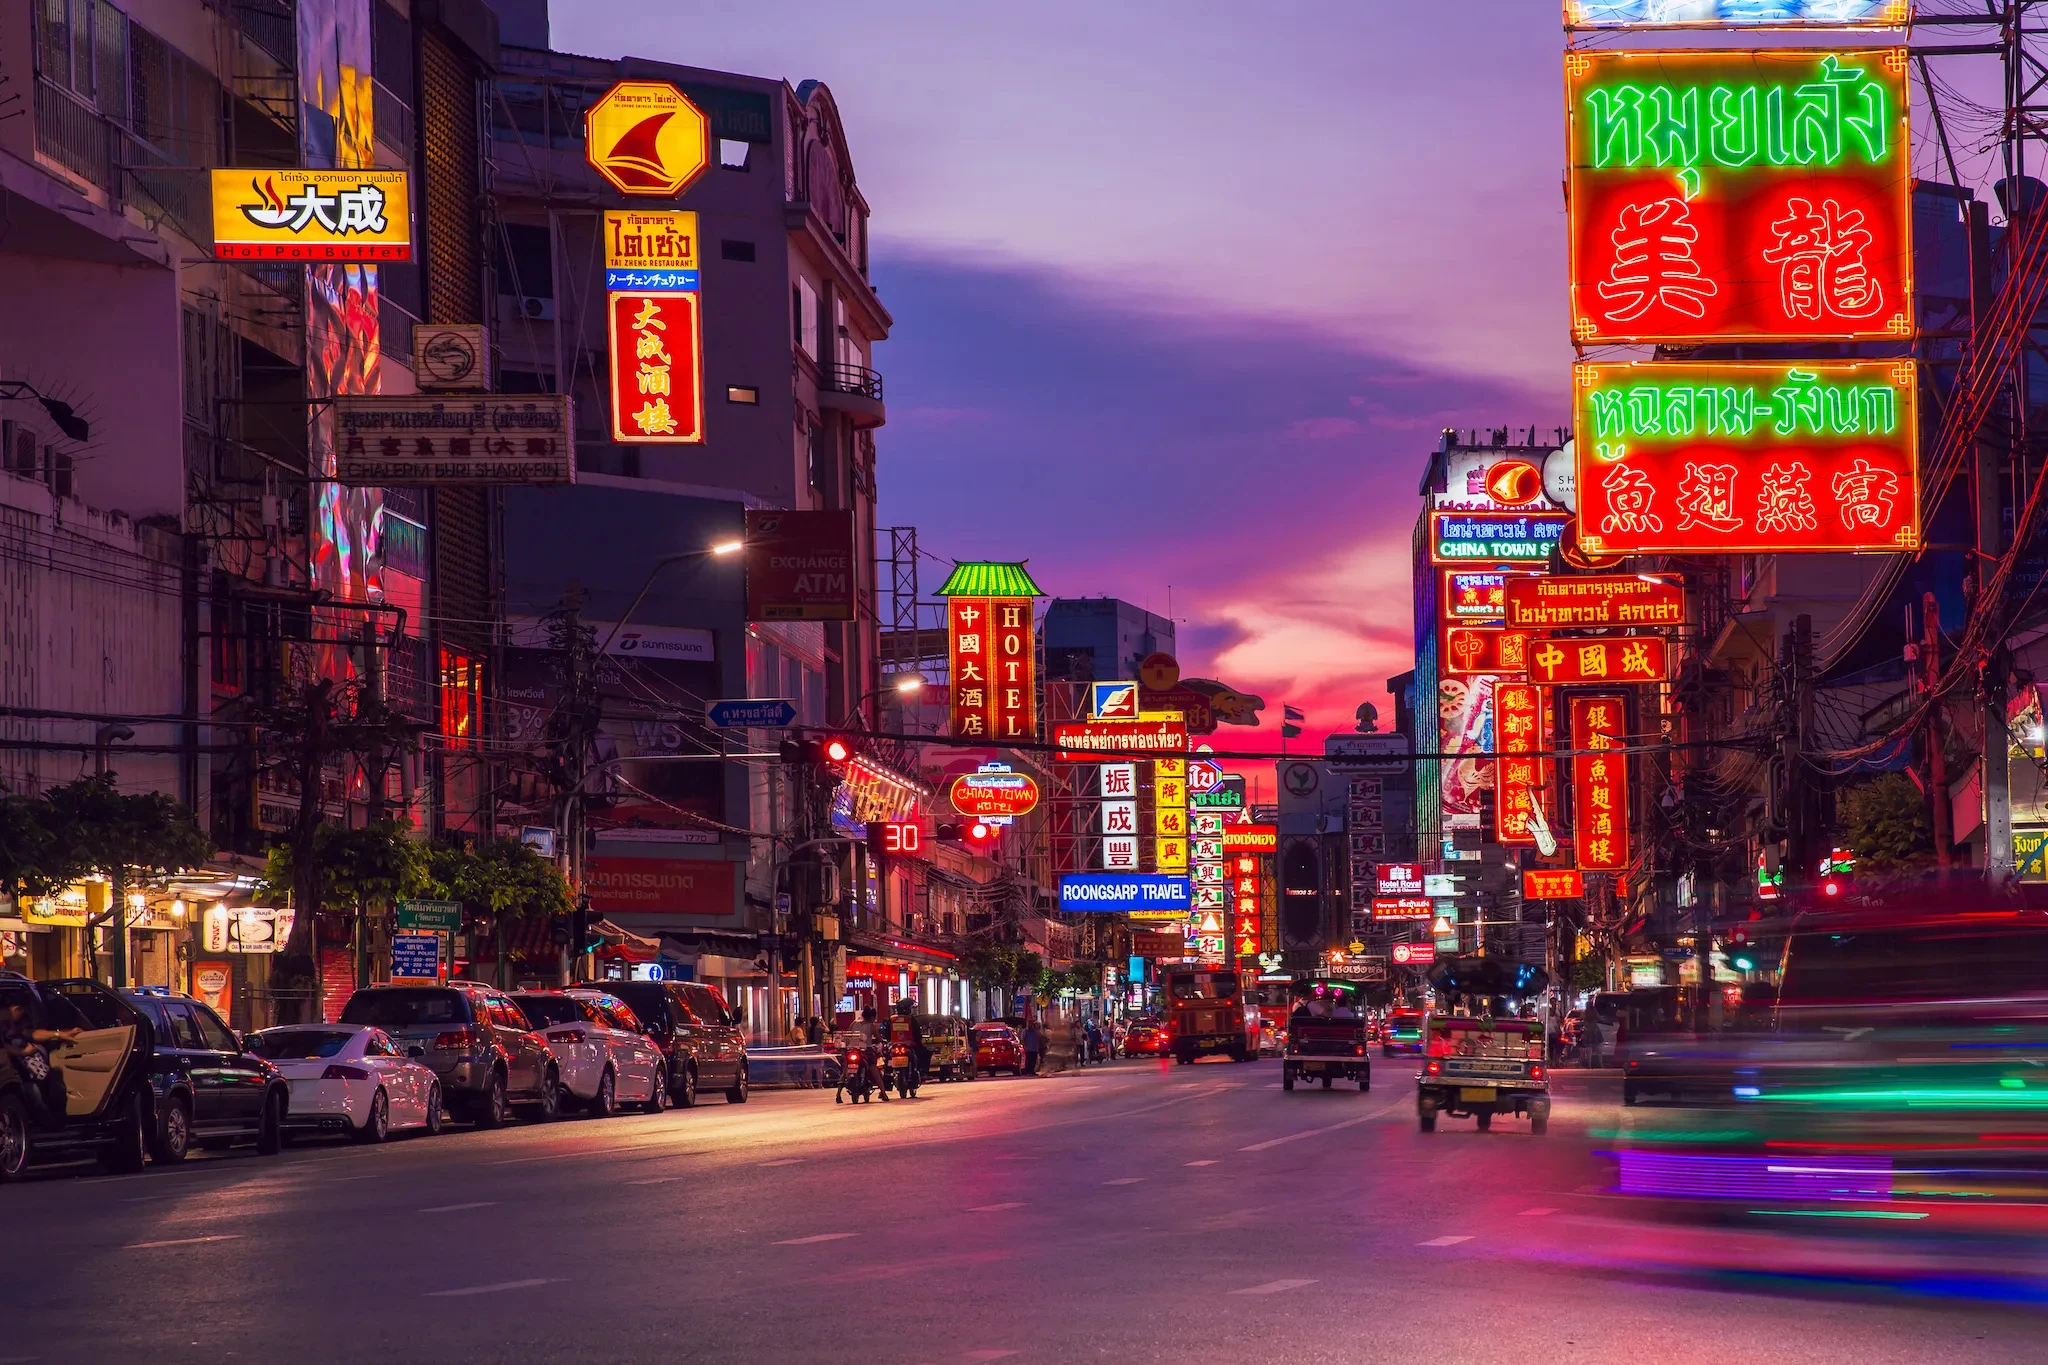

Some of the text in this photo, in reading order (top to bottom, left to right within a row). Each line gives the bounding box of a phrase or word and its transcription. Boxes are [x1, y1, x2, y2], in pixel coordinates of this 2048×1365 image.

[288, 185, 387, 235] 大成
[223, 246, 403, 257] Hot Pot Buffet
[1597, 197, 1884, 321] 美龍
[611, 259, 622, 267] TAI
[624, 259, 647, 267] ZHENG
[1602, 459, 1898, 533] 魚翅燕窩
[1440, 543, 1487, 556] CHINA
[1491, 543, 1536, 556] TOWN
[770, 556, 848, 568] EXCHANGE
[793, 573, 846, 593] ATM
[1456, 605, 1493, 613] SHARK'S
[1511, 597, 1679, 623] ไชน่าทาวน์ สกาล่า
[1455, 631, 1527, 671] 中國
[1536, 642, 1655, 680] 中國城
[959, 605, 984, 736] 中國大酒店
[1003, 607, 1021, 736] HOTEL
[957, 788, 1033, 800] CHINA TOWN
[1586, 706, 1615, 864] 銀都魚翅酒樓
[977, 802, 1013, 812] HOTEL
[1106, 769, 1133, 866] 振成豐
[685, 834, 707, 842] 1770
[886, 825, 918, 851] 30
[1063, 884, 1186, 900] ROONGSARP TRAVEL
[1200, 818, 1216, 953] 和成興大行
[1380, 880, 1421, 889] Hotel Royal
[636, 892, 660, 900] Bank
[855, 978, 872, 988] Hotel
